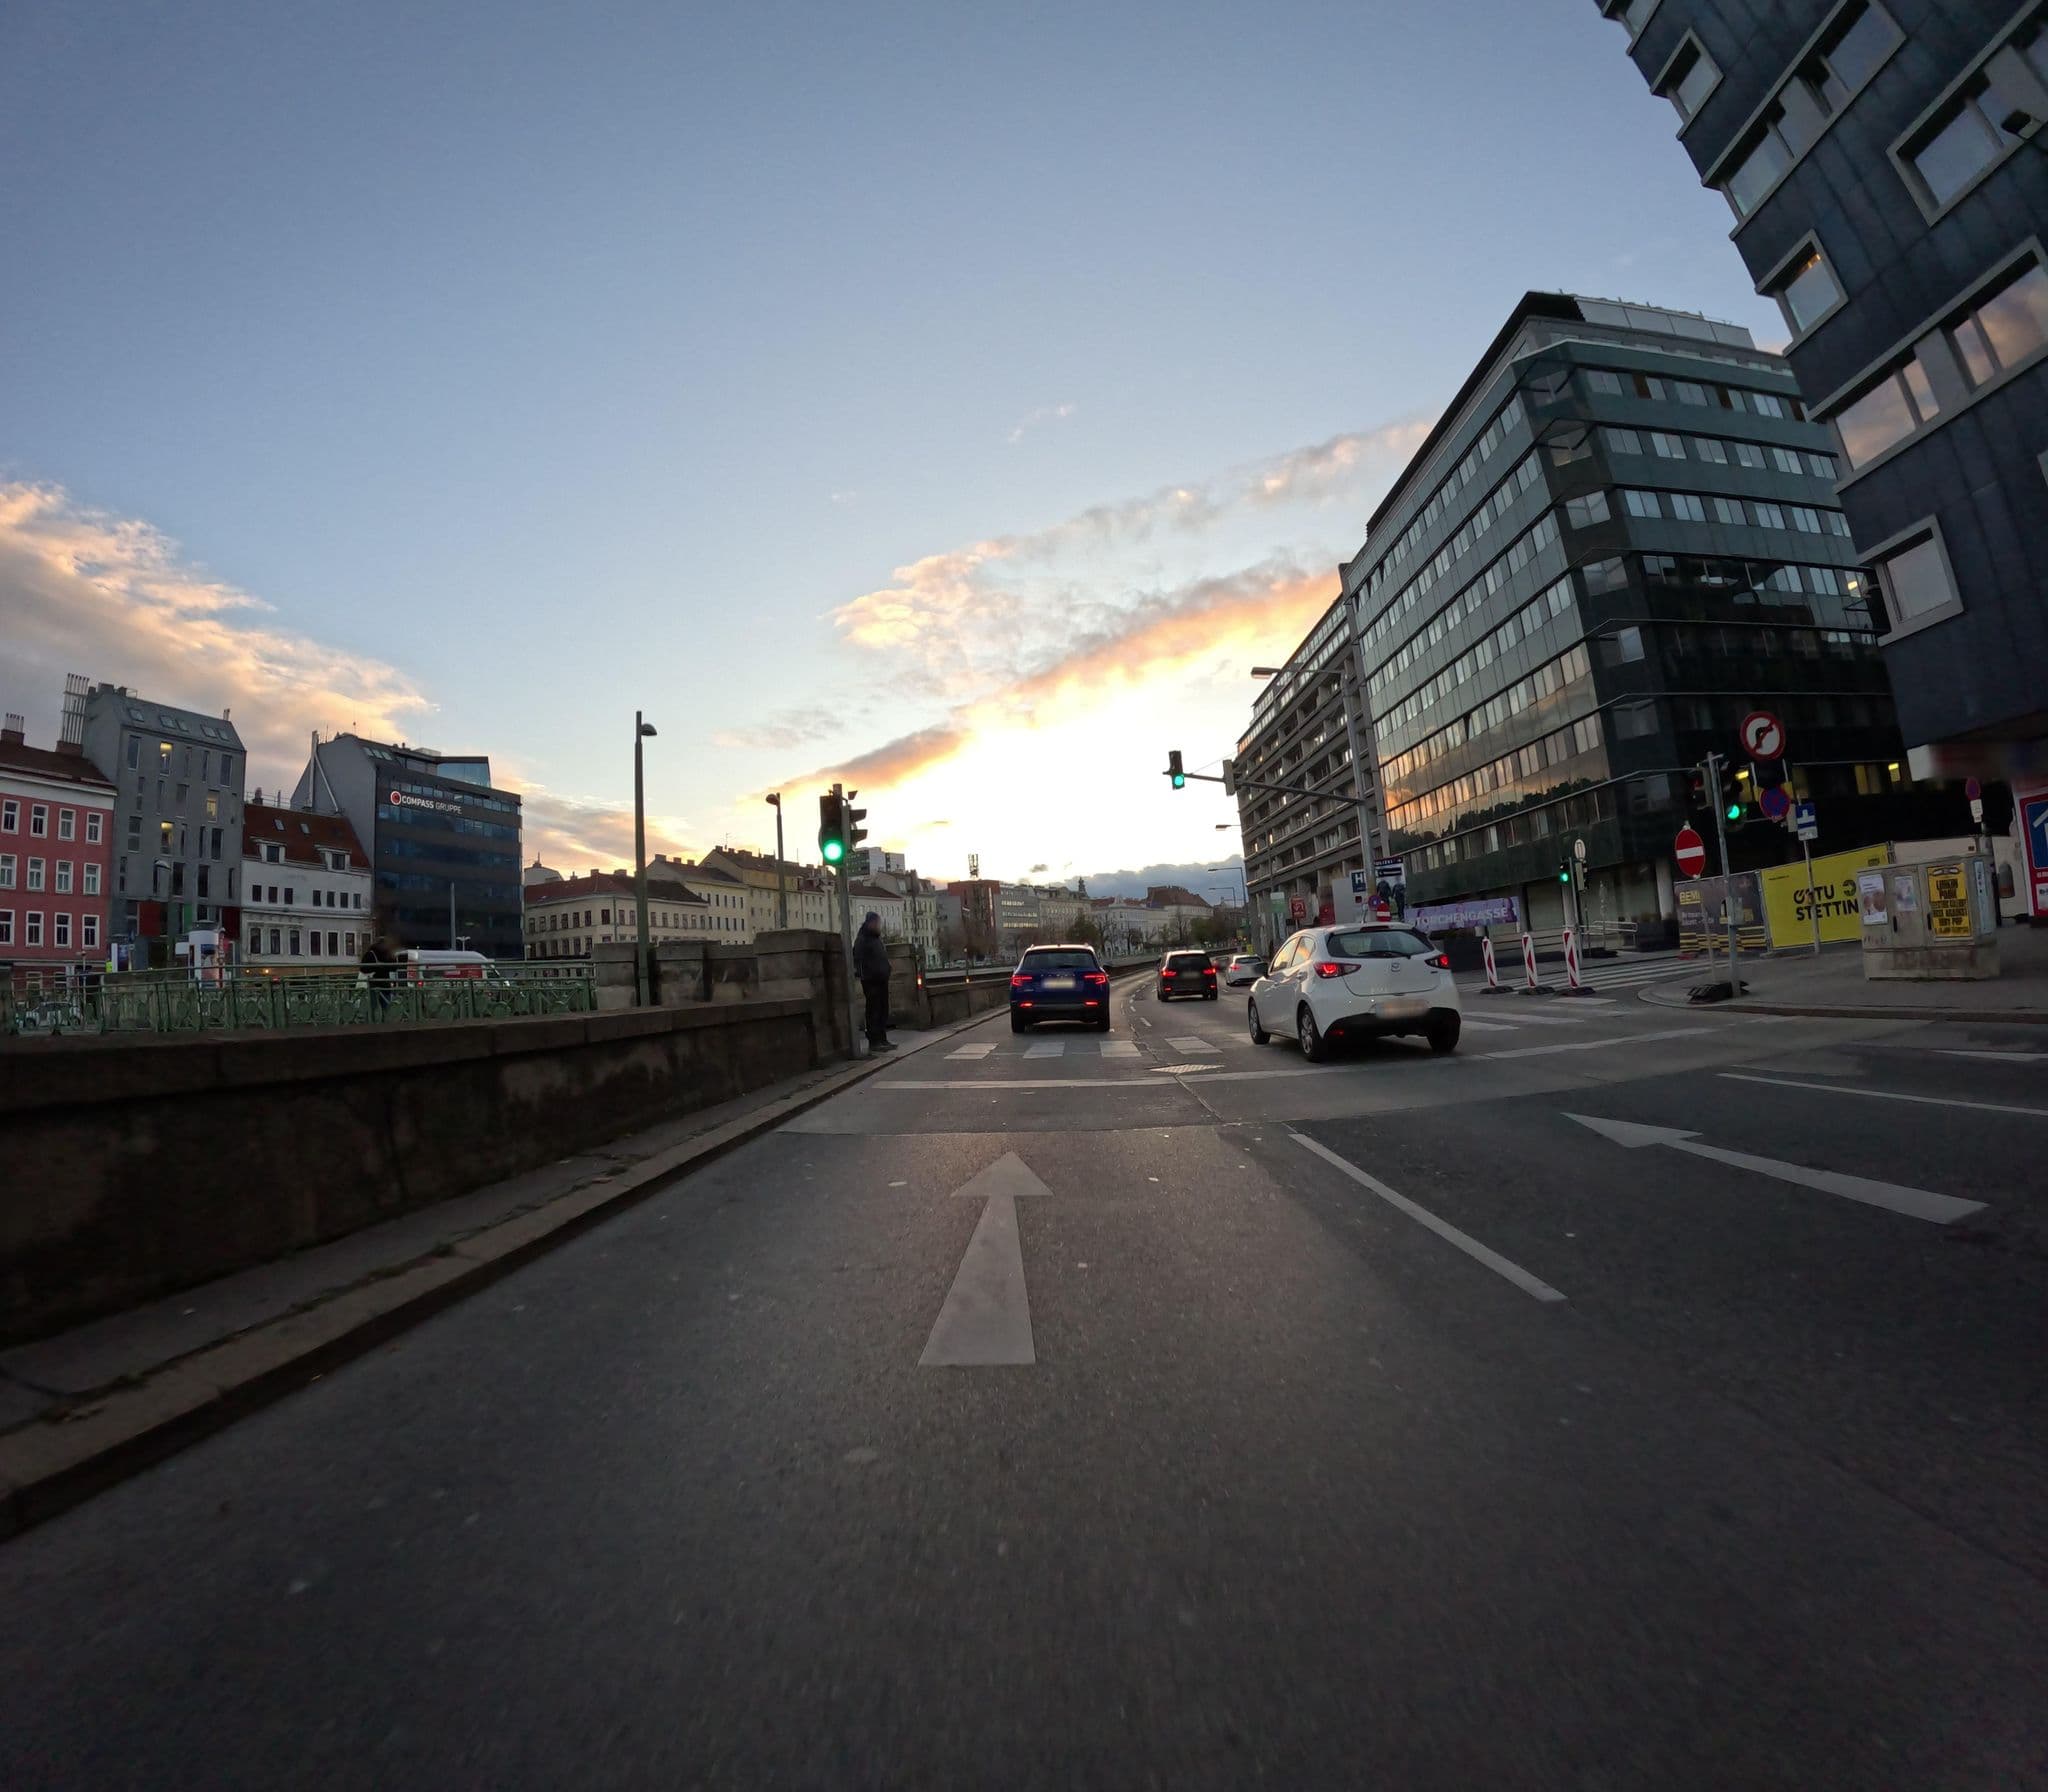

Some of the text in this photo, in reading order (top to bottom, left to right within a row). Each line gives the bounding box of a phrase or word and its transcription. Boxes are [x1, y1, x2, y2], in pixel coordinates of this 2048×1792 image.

[401, 795, 463, 815] COMPASS GRUPPE
[1796, 898, 1859, 921] STETTIN
